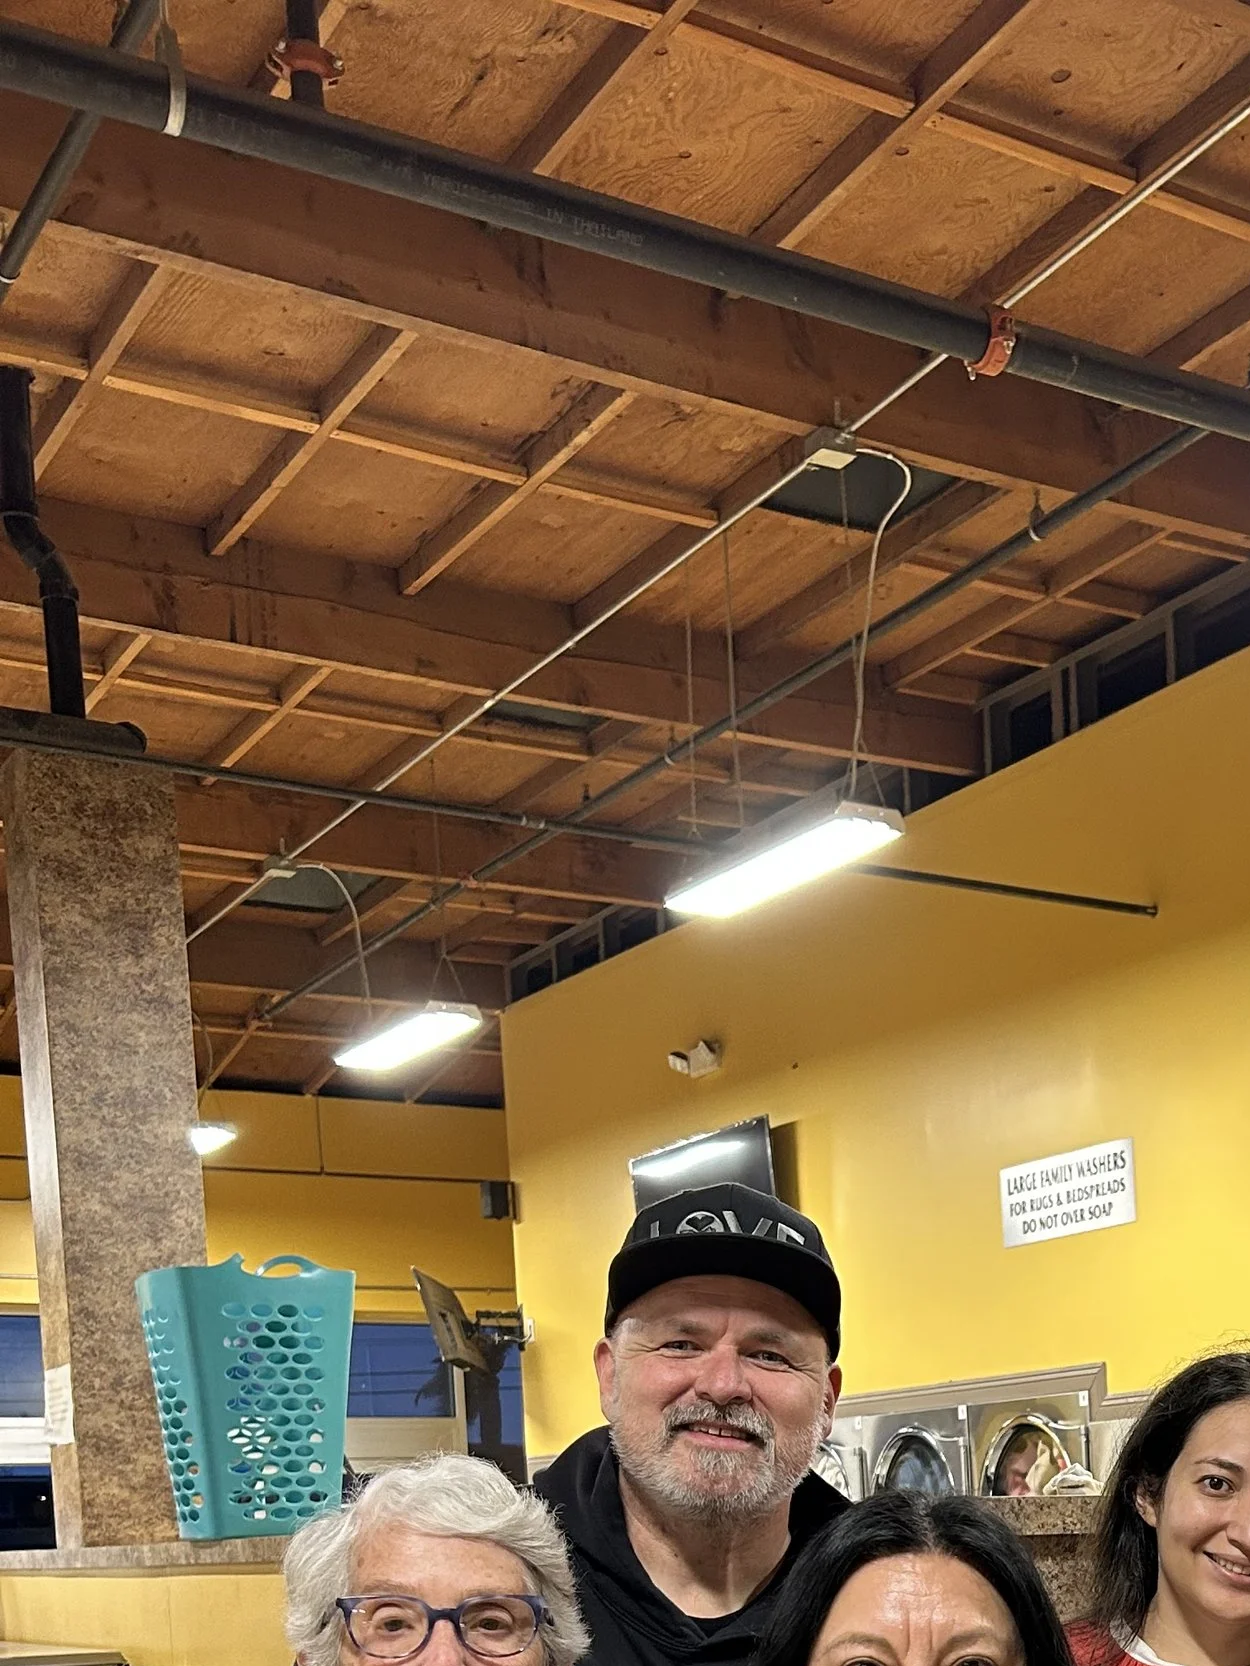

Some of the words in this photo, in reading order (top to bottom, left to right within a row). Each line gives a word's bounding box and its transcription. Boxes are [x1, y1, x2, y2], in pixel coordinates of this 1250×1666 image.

[1007, 1172, 1037, 1196] LARGE
[1040, 1163, 1073, 1188] FAMILY
[1075, 1150, 1127, 1179] WASHERS
[1009, 1201, 1027, 1218] FOR
[1030, 1194, 1053, 1212] RUGS
[1056, 1192, 1063, 1207] &
[1066, 1177, 1126, 1204] BEDSPREADS
[1022, 1218, 1036, 1234] DO
[1039, 1213, 1058, 1231] NOT
[1061, 1207, 1086, 1227] OVER
[1088, 1201, 1113, 1220] SOAP
